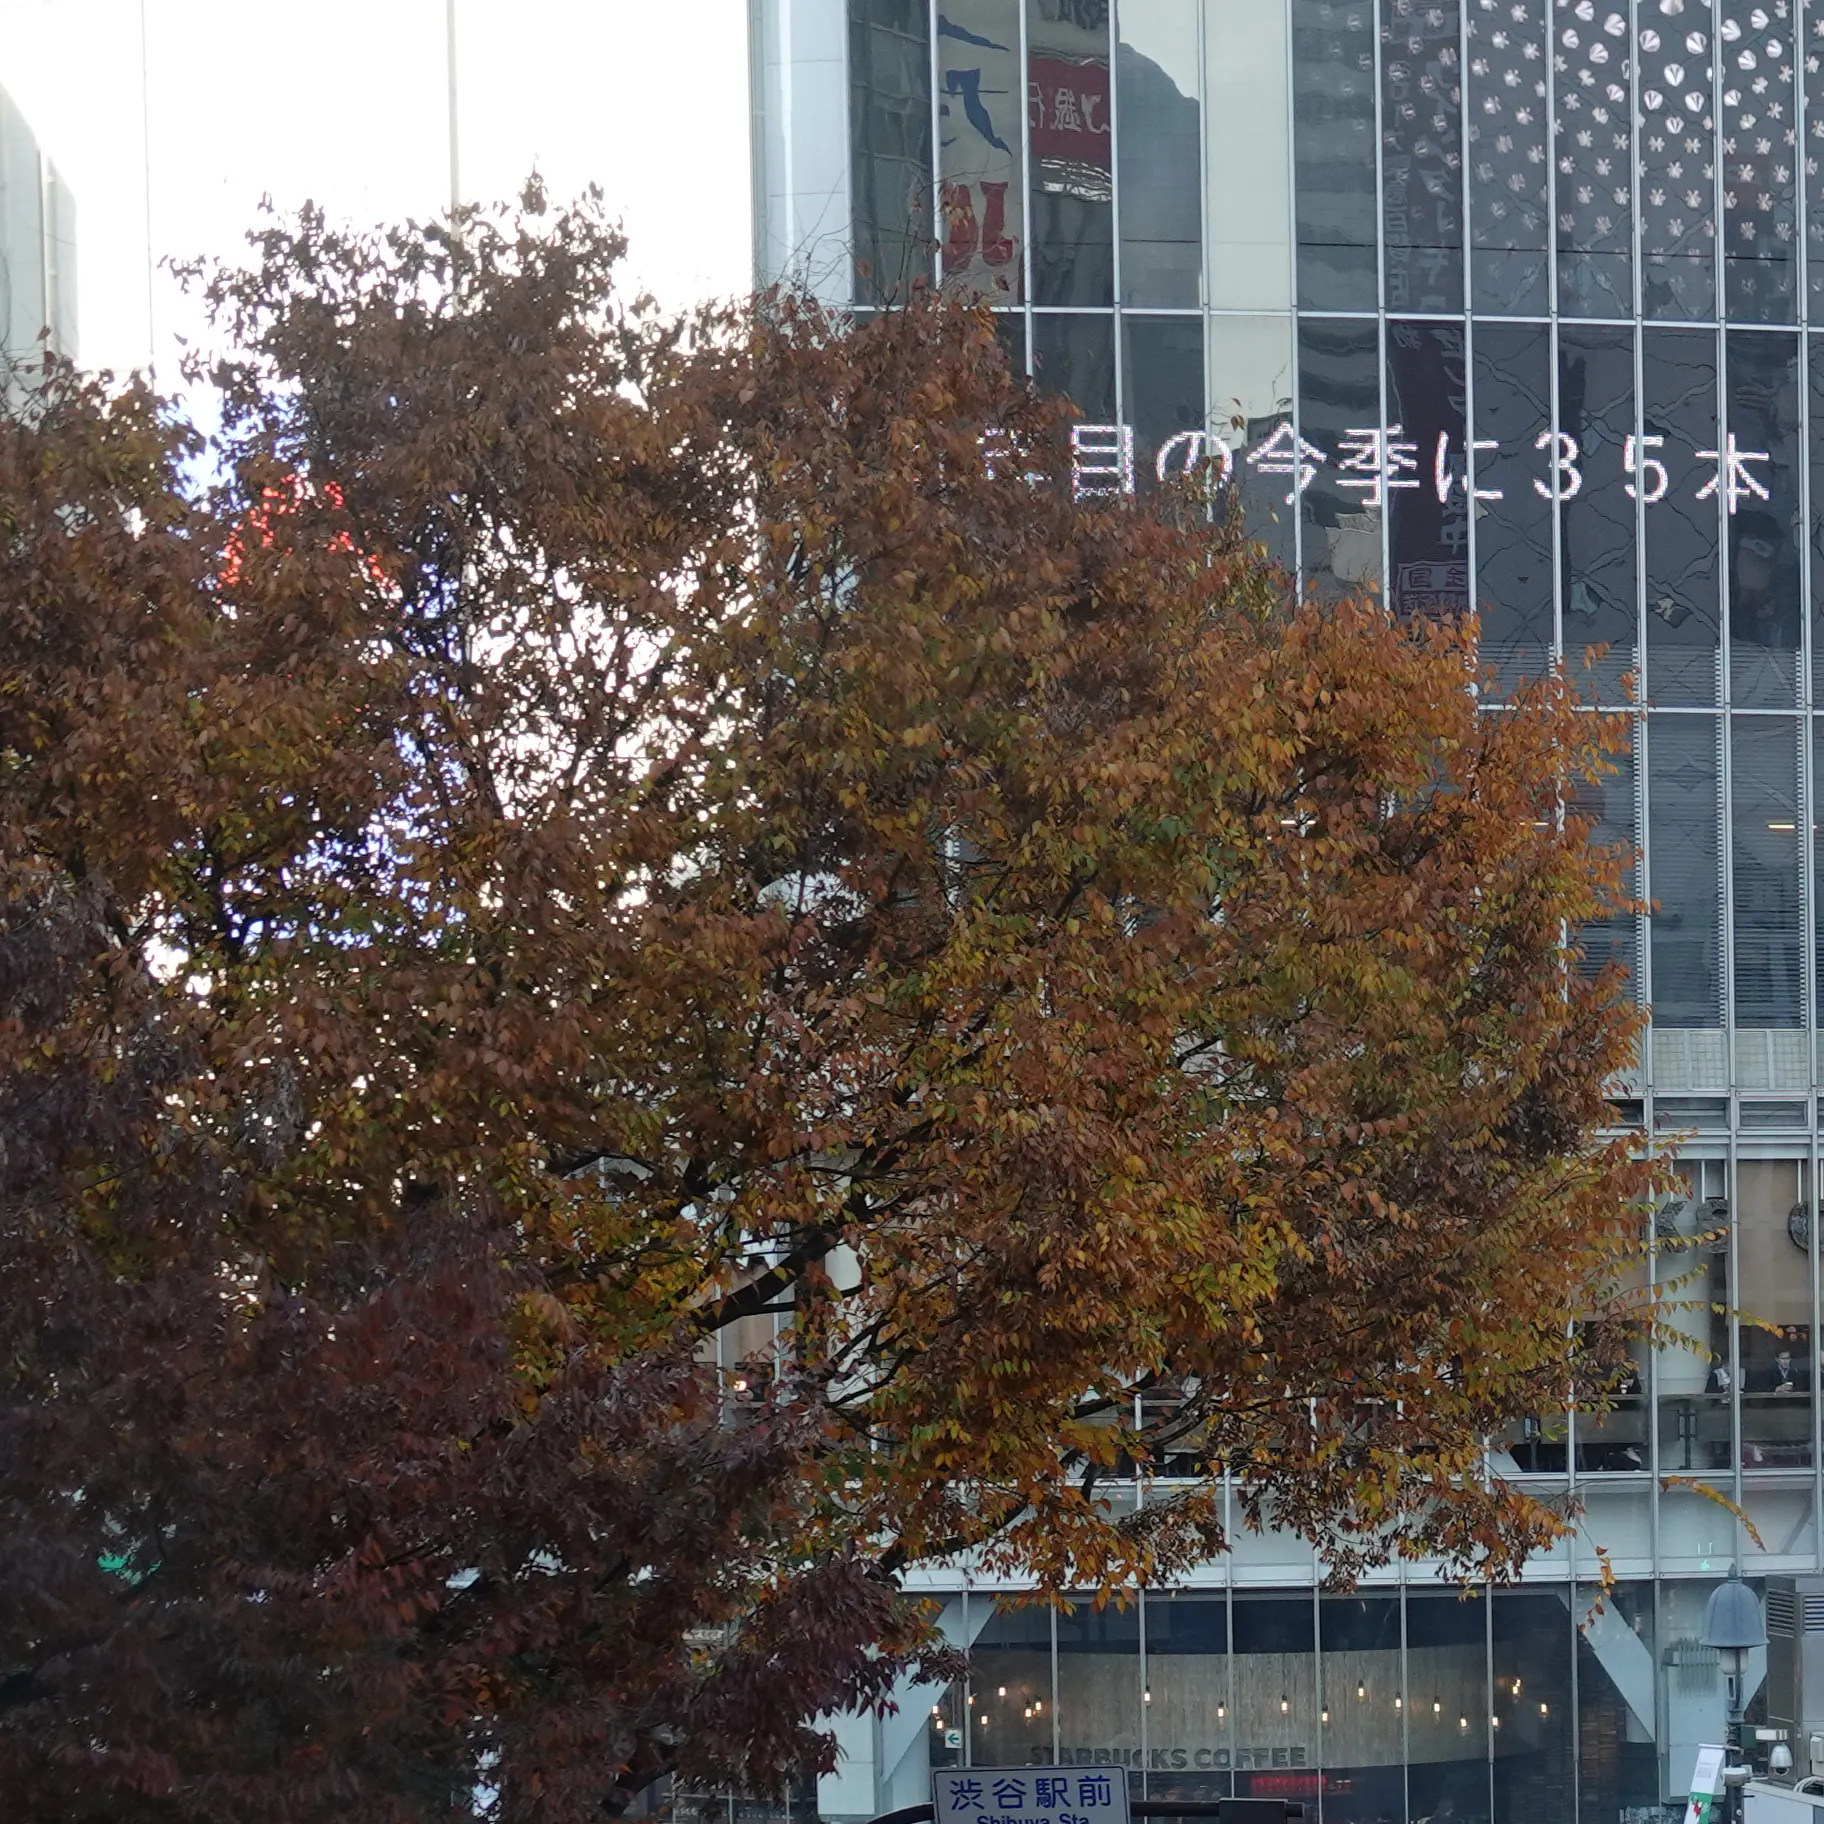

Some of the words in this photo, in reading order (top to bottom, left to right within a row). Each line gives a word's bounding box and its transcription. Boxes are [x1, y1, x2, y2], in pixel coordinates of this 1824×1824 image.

[1031, 1747, 1188, 1771] STARBUCKS
[1193, 1746, 1307, 1770] COFFEE
[949, 1774, 1113, 1812] 渋谷駅前
